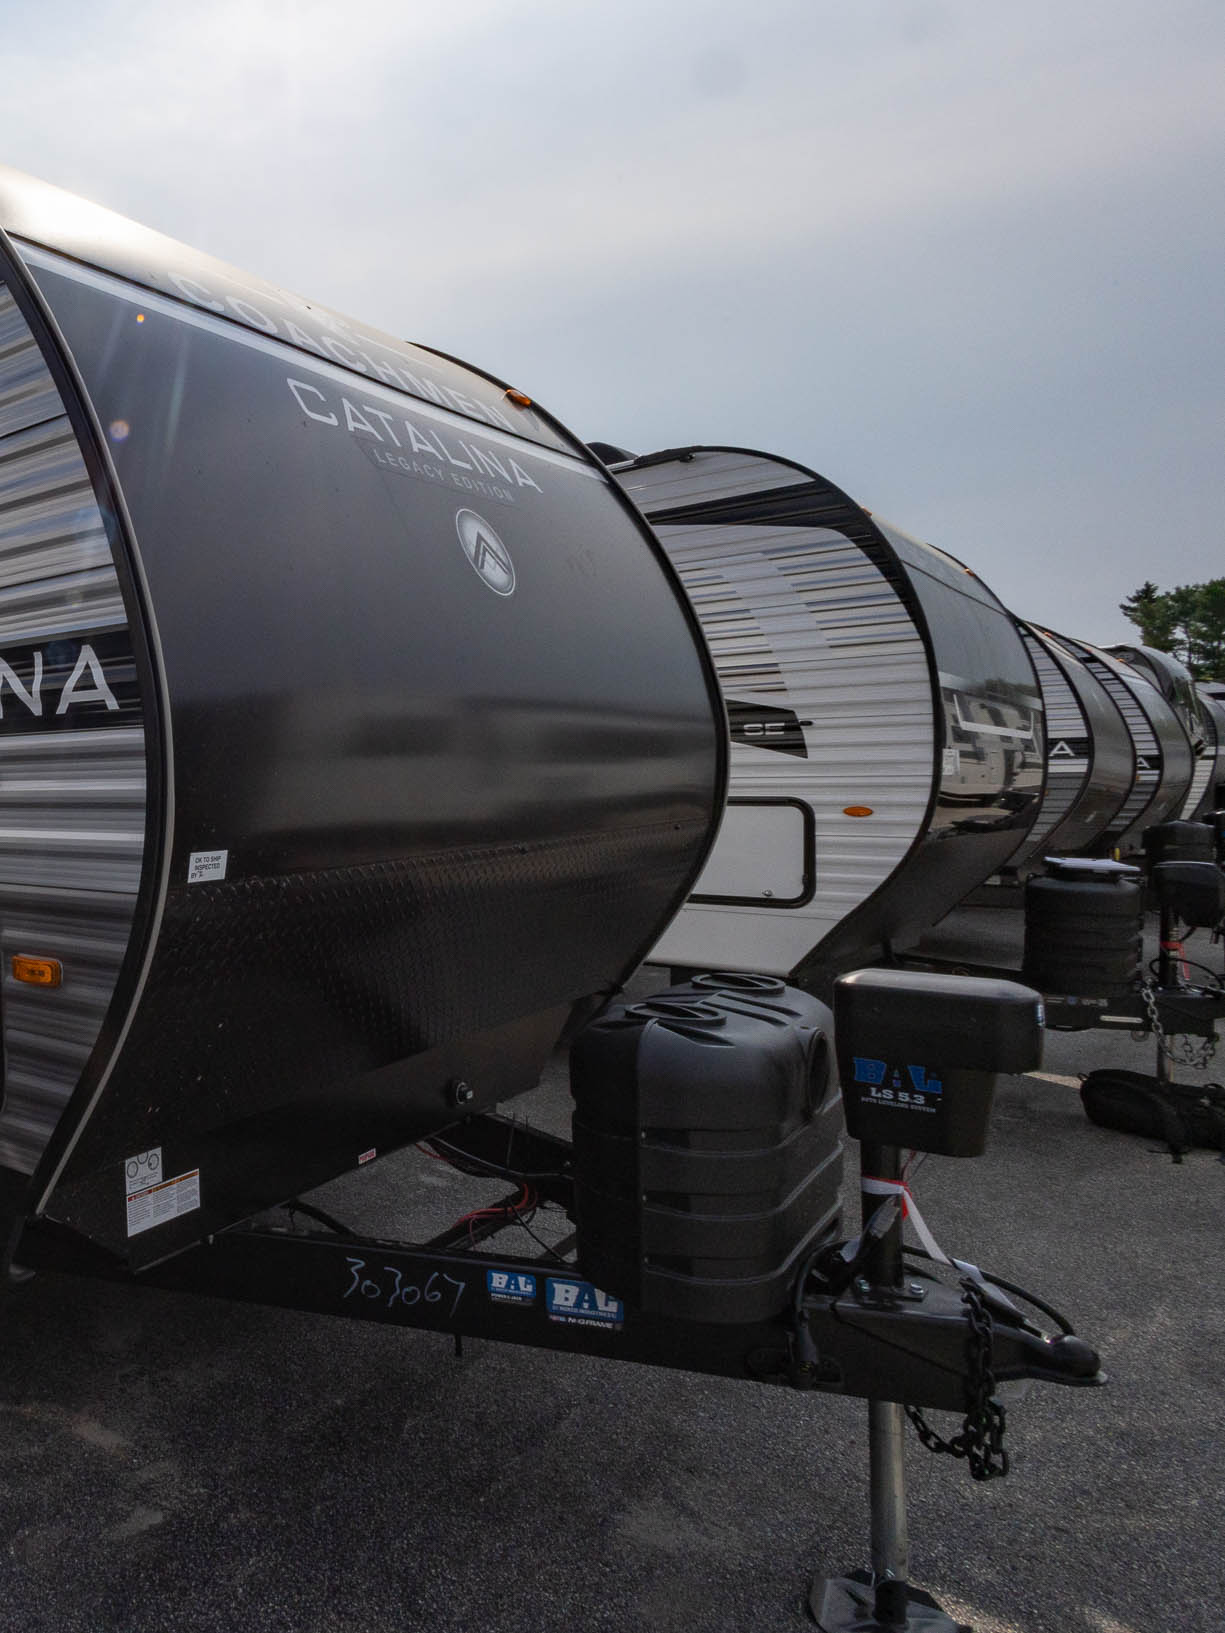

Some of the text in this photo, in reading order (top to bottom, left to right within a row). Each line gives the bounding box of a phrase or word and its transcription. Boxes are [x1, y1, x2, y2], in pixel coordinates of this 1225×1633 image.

[168, 271, 519, 432] COACHMEN
[287, 377, 544, 495] CATALINA
[373, 447, 516, 502] LEGACY EDITION
[853, 1056, 943, 1094] BAL
[870, 1087, 895, 1100] LS
[344, 1256, 467, 1318] 303067
[491, 1272, 533, 1292] BAL
[552, 1282, 618, 1313] BAL
